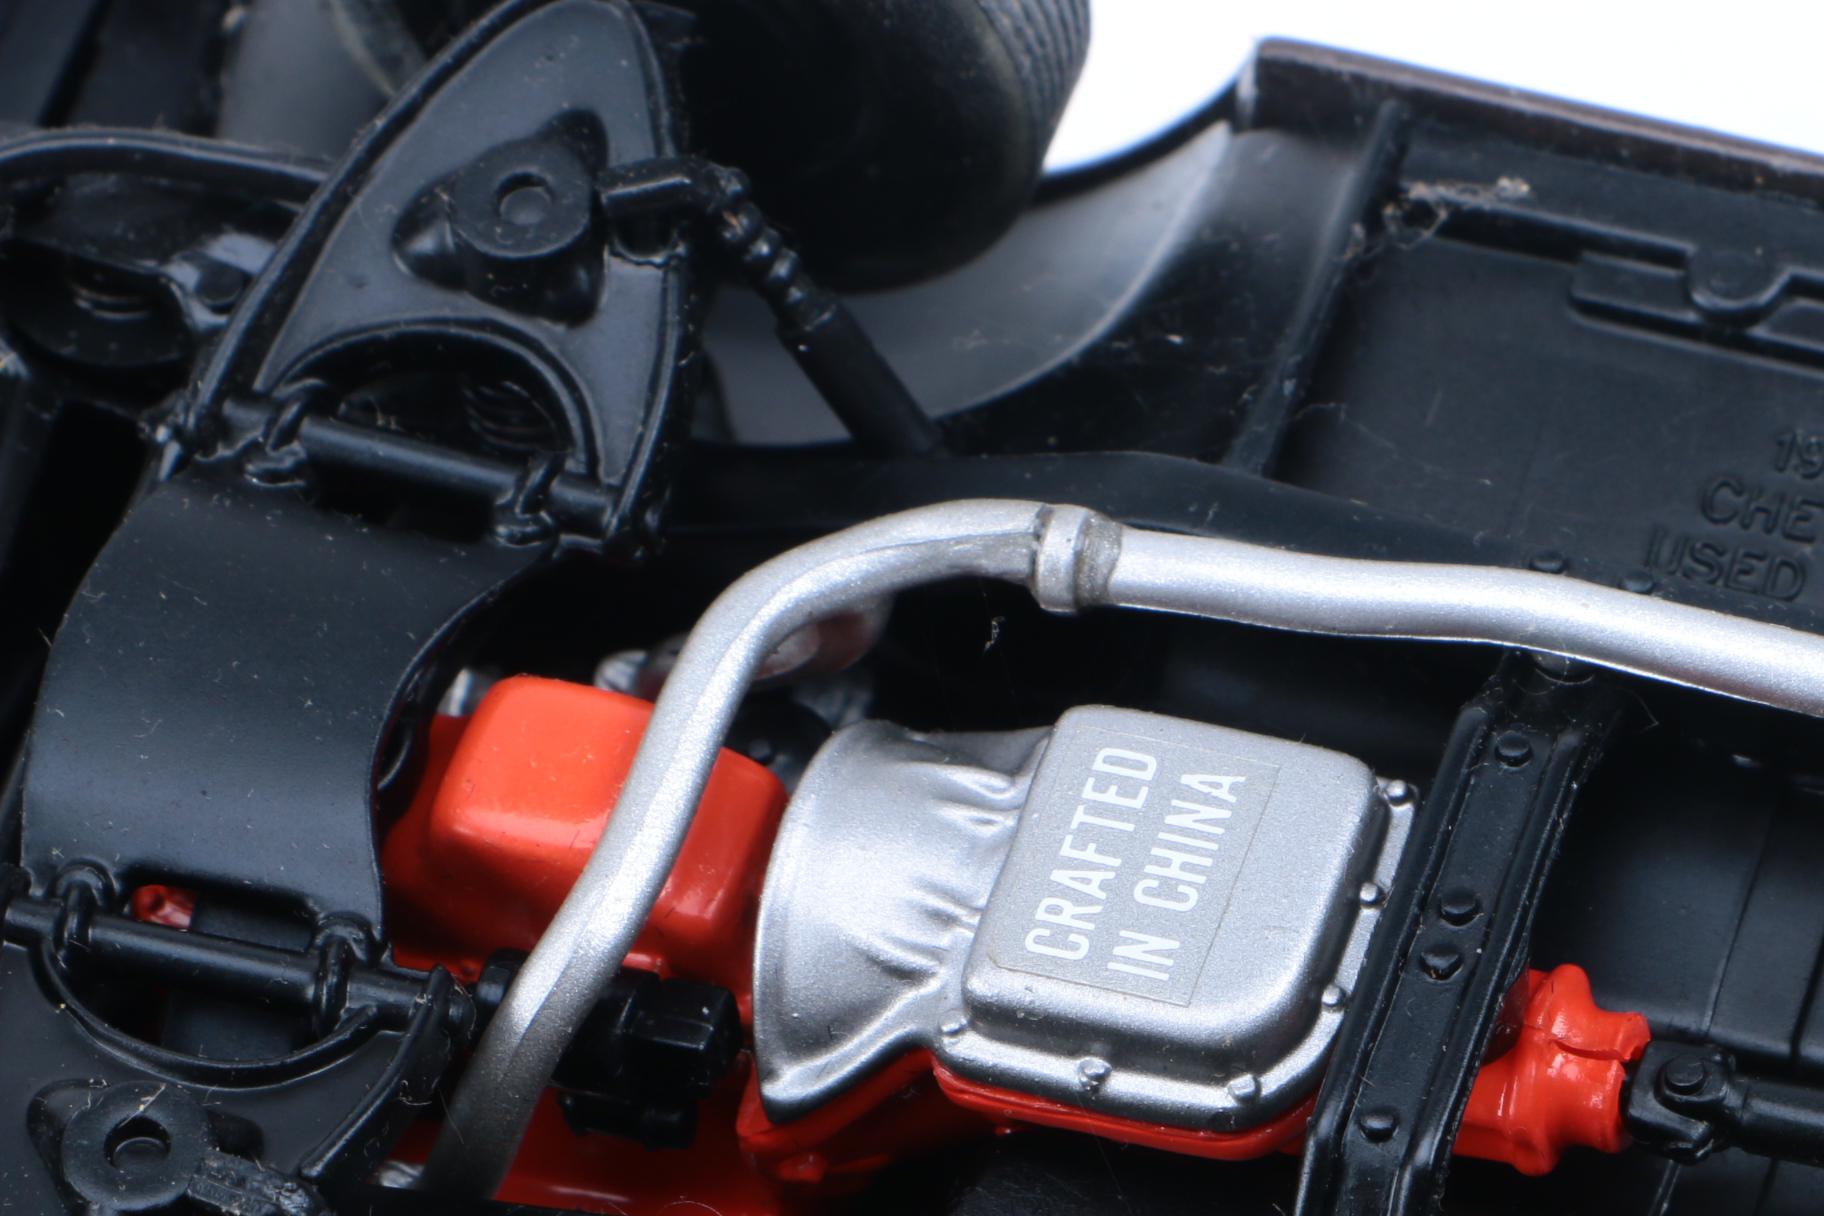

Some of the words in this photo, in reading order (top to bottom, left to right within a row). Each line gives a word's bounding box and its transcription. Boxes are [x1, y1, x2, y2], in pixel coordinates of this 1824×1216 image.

[1644, 522, 1808, 604] USED
[1024, 746, 1159, 961] CRAFTED
[1133, 772, 1247, 913] CHINA
[1106, 929, 1181, 981] IN
